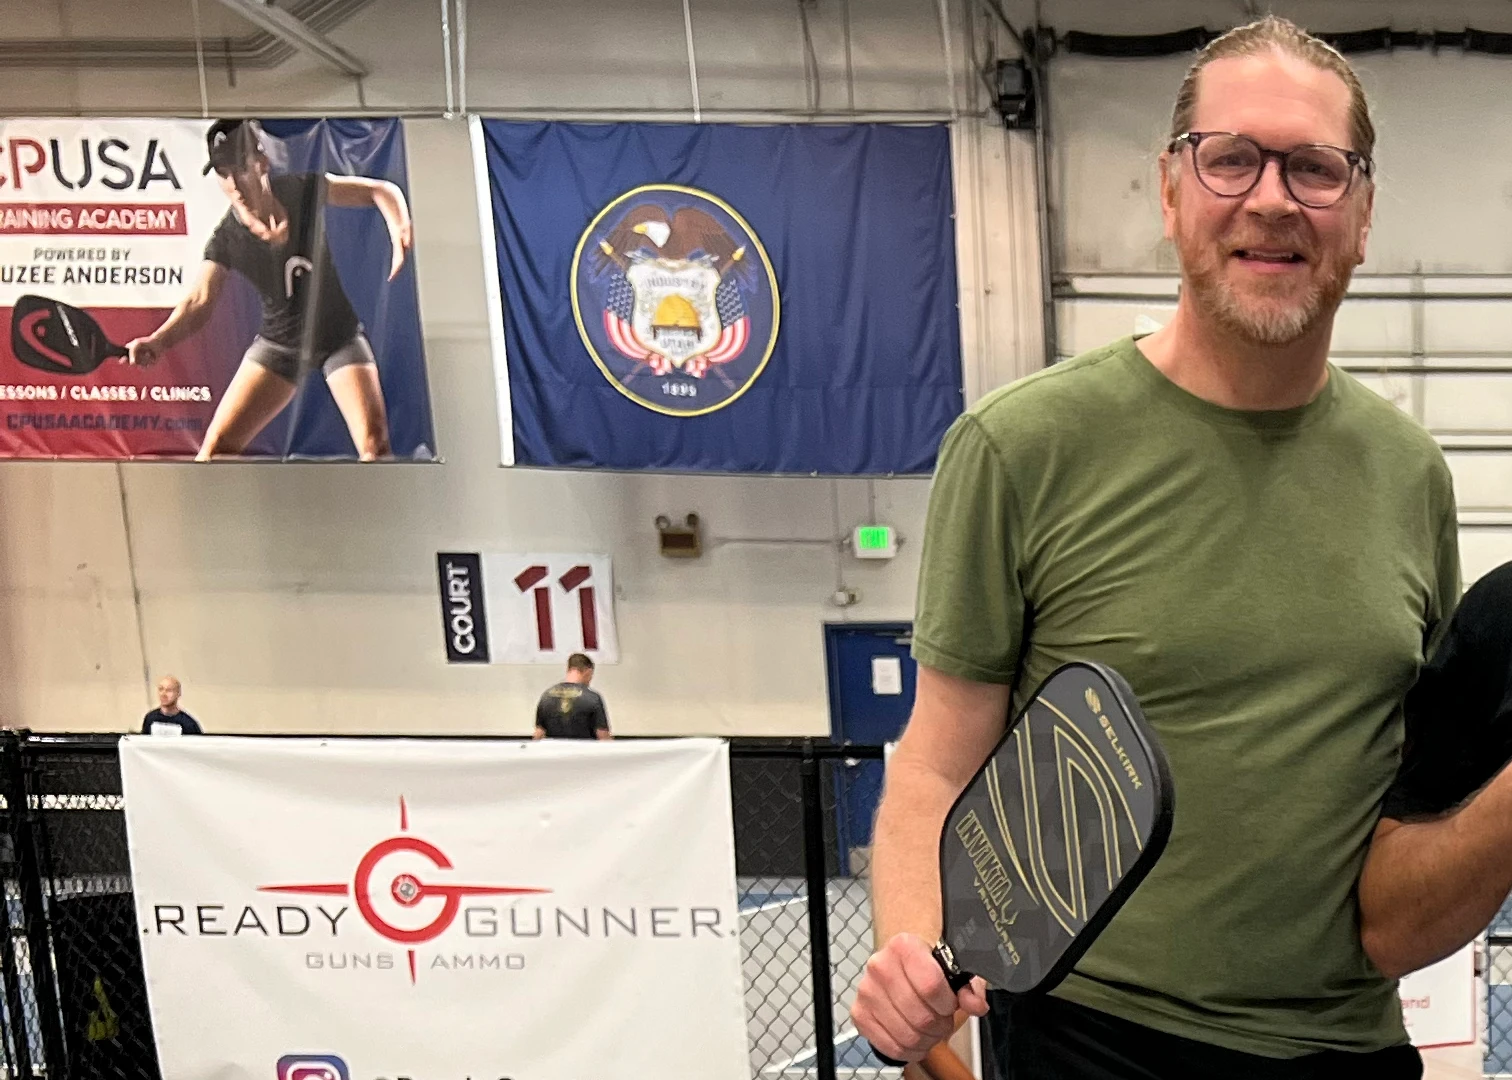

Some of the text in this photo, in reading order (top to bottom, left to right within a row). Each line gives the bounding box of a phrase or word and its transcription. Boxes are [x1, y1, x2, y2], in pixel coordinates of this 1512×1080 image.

[0, 137, 183, 190] PUSA
[77, 208, 179, 230] ACADEMY
[33, 247, 132, 262] POWERED BY
[63, 265, 183, 285] ANDERSON
[70, 384, 139, 401] CLASSES
[150, 385, 212, 402] CLINICS
[446, 561, 477, 655] COURT
[513, 565, 599, 651] 11
[1099, 714, 1143, 790] SELKIRK
[305, 952, 526, 971] GUNS AMMO
